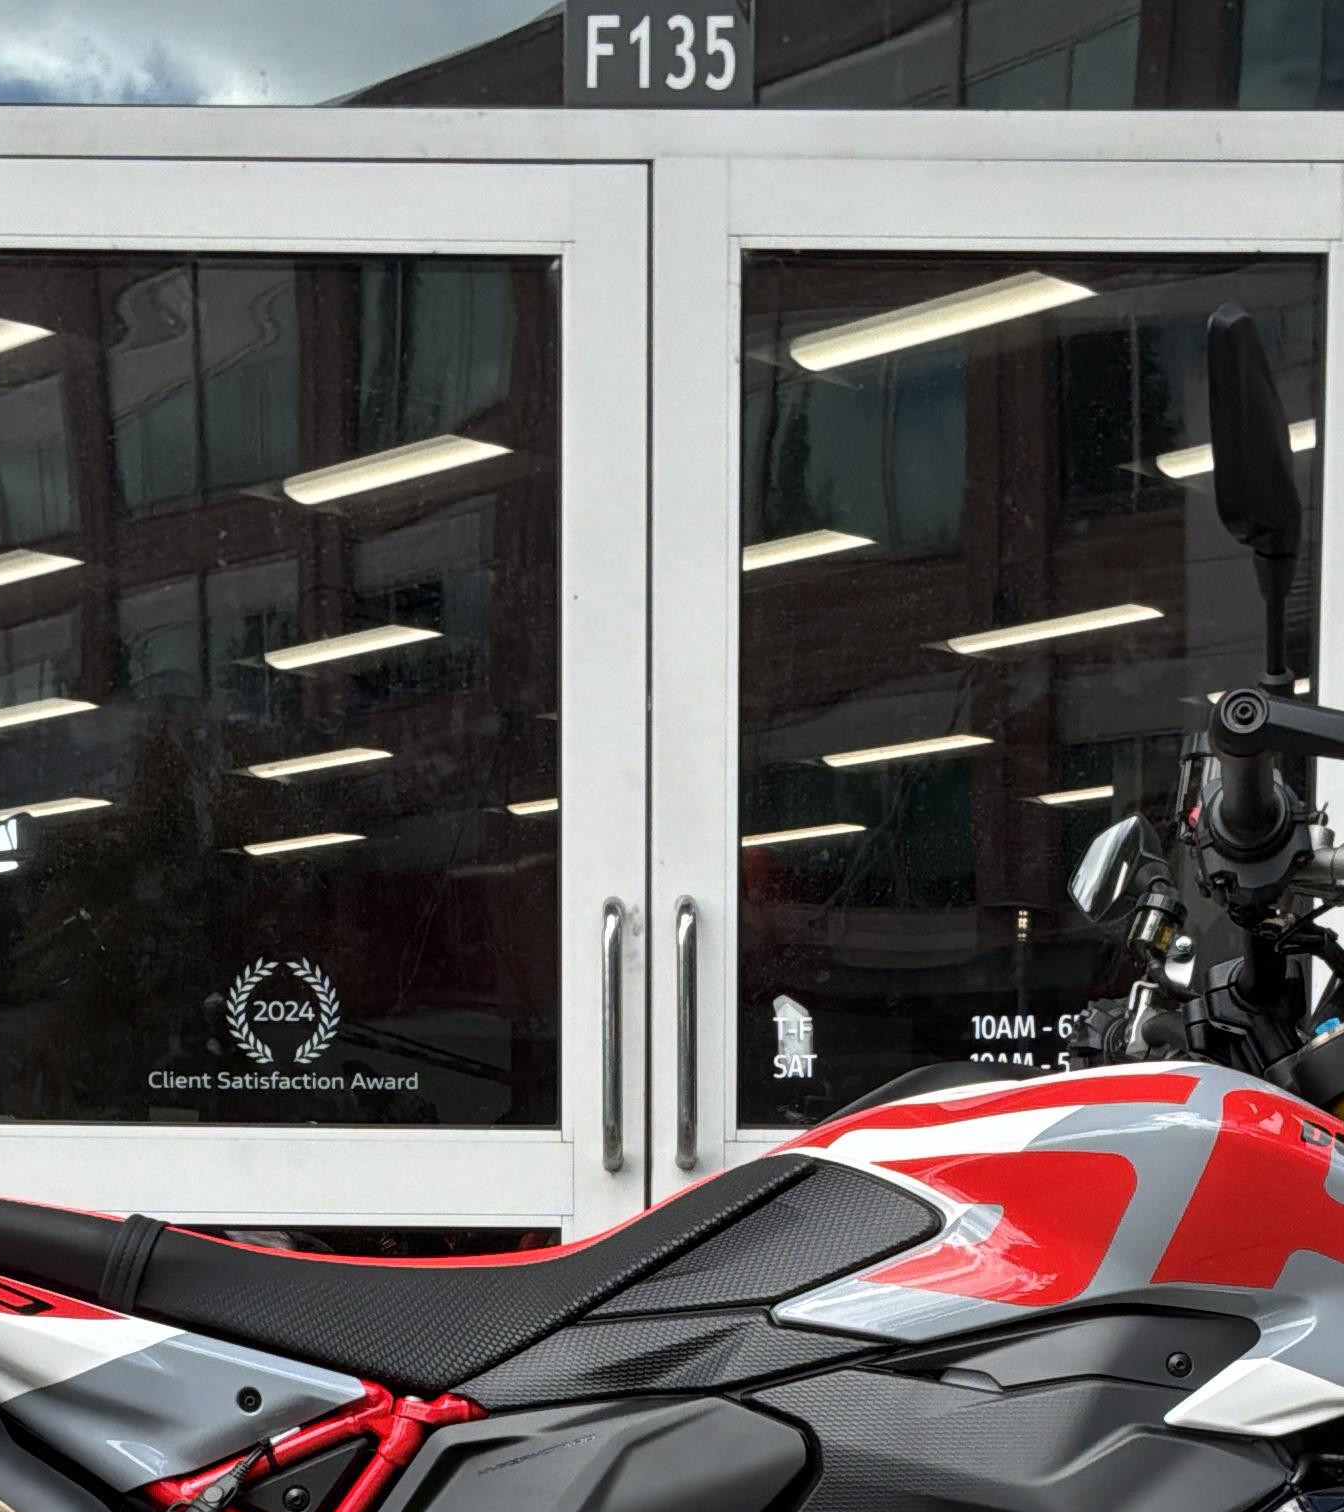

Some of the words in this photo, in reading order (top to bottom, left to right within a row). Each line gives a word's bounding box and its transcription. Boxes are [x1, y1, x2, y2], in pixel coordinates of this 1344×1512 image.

[586, 14, 736, 91] F135
[253, 1001, 316, 1022] 2024
[773, 1017, 813, 1041] T-F
[971, 1015, 1036, 1040] 10AM
[773, 1054, 817, 1079] SAT
[148, 1071, 211, 1091] Client
[217, 1071, 345, 1091] Satisfaction
[350, 1072, 419, 1091] Award
